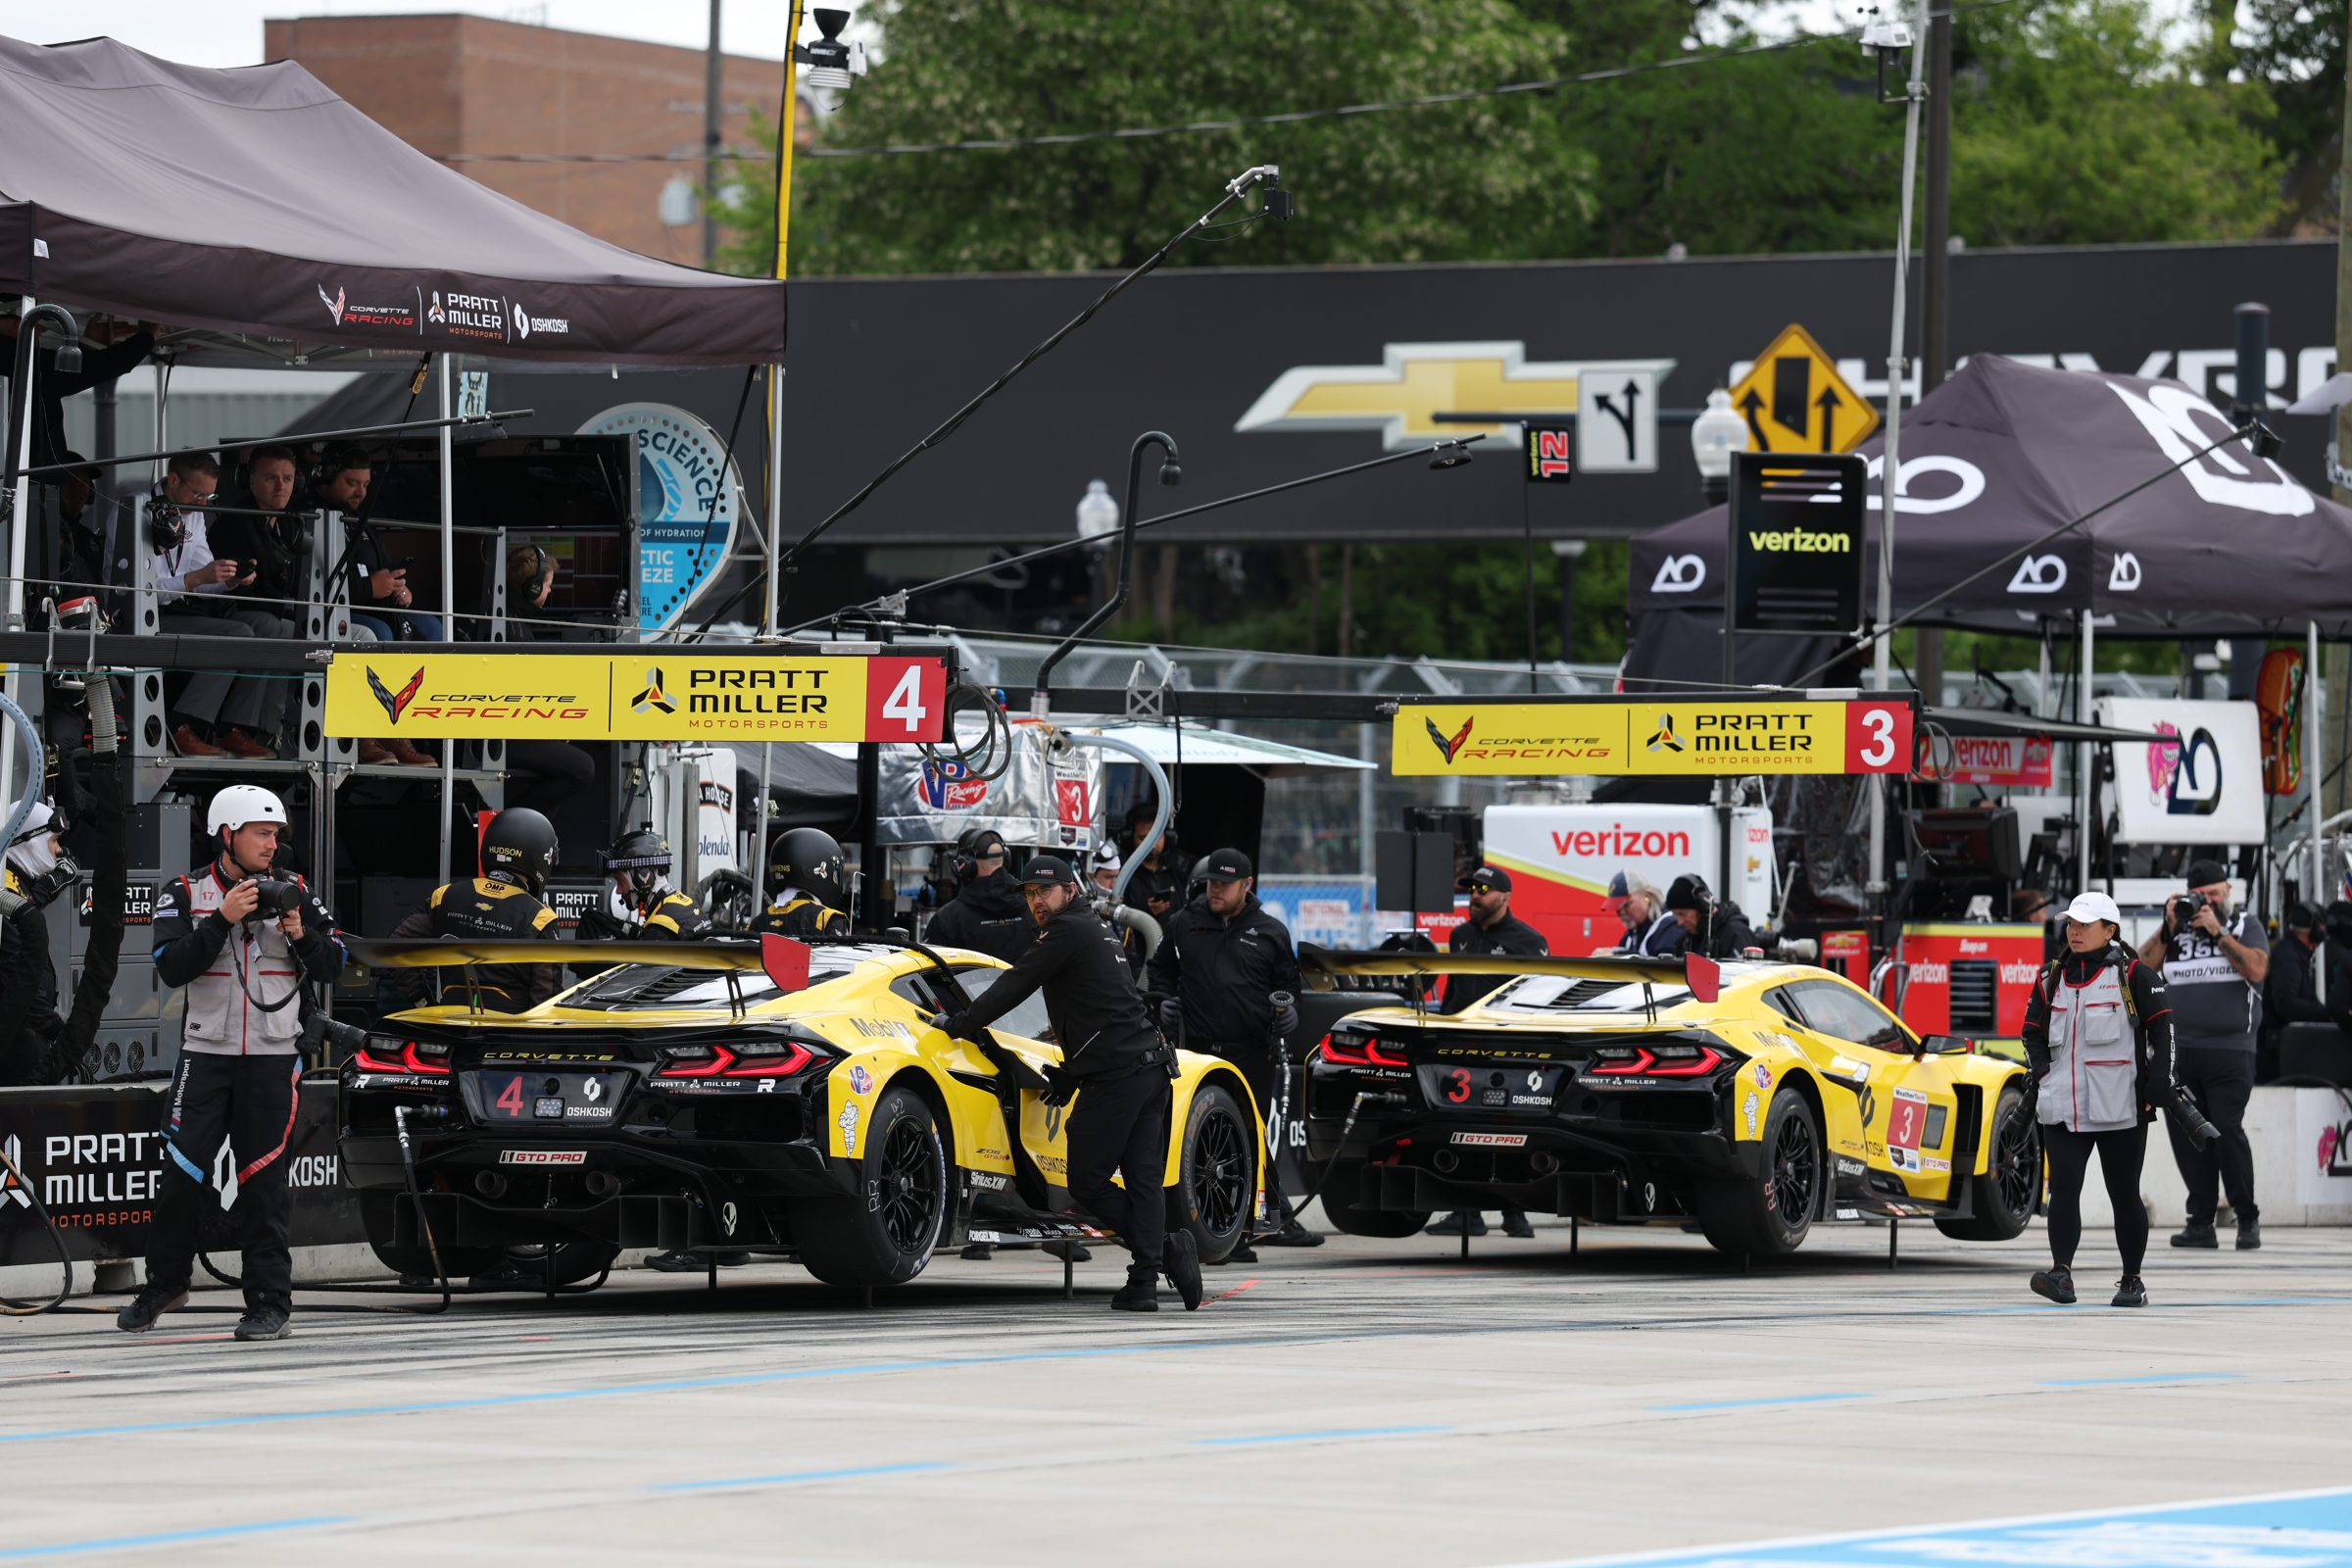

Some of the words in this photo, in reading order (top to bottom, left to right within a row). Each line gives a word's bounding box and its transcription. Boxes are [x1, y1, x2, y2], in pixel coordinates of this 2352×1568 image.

[447, 293, 499, 312] PRATT
[349, 305, 410, 315] CORVETTE
[344, 313, 415, 326] RACING
[448, 309, 502, 329] MILLER
[530, 318, 568, 334] OSHKOSH
[449, 327, 503, 340] MOTORSPORTS
[1540, 430, 1569, 478] 12
[637, 428, 713, 512] SCIENCE
[1749, 526, 1850, 553] verizon
[640, 597, 651, 606] EL
[640, 607, 652, 616] RE
[690, 669, 829, 688] PRATT
[429, 693, 576, 704] CORVETTE
[689, 694, 828, 714] MILLER
[882, 664, 926, 732] 4
[412, 707, 589, 720] RACING
[689, 719, 829, 729] MOTORSPORTS
[1696, 714, 1813, 730] PRATT
[1695, 734, 1812, 752] MILLER
[1860, 709, 1895, 767] 3
[1463, 748, 1610, 759] RACING
[947, 783, 988, 803] Racing
[1070, 785, 1082, 823] 3
[1551, 823, 1690, 857] verizon
[488, 846, 523, 858] HUDSON
[484, 882, 506, 892] OMP
[202, 891, 216, 902] 17
[556, 893, 599, 906] PRATT
[485, 920, 513, 931] MILLER
[1419, 912, 1467, 927] verizon
[484, 1053, 614, 1061] CORVETTE
[1438, 1049, 1551, 1058] CORVETTE
[173, 1057, 191, 1107] Motorsport
[1447, 1068, 1471, 1103] 3
[496, 1075, 524, 1117] 4
[1512, 1095, 1552, 1106] OSHKOSH
[566, 1106, 612, 1117] OSHKOSH
[1899, 1105, 1914, 1145] 3
[1465, 1135, 1493, 1144] GTD
[514, 1152, 542, 1162] GTD
[549, 1153, 583, 1163] PRO
[1937, 1159, 1950, 1170] PRO
[1036, 1154, 1068, 1176] OSHKOS
[970, 1171, 1007, 1192] SiriusXM
[968, 1229, 1001, 1243] FORGELINE
